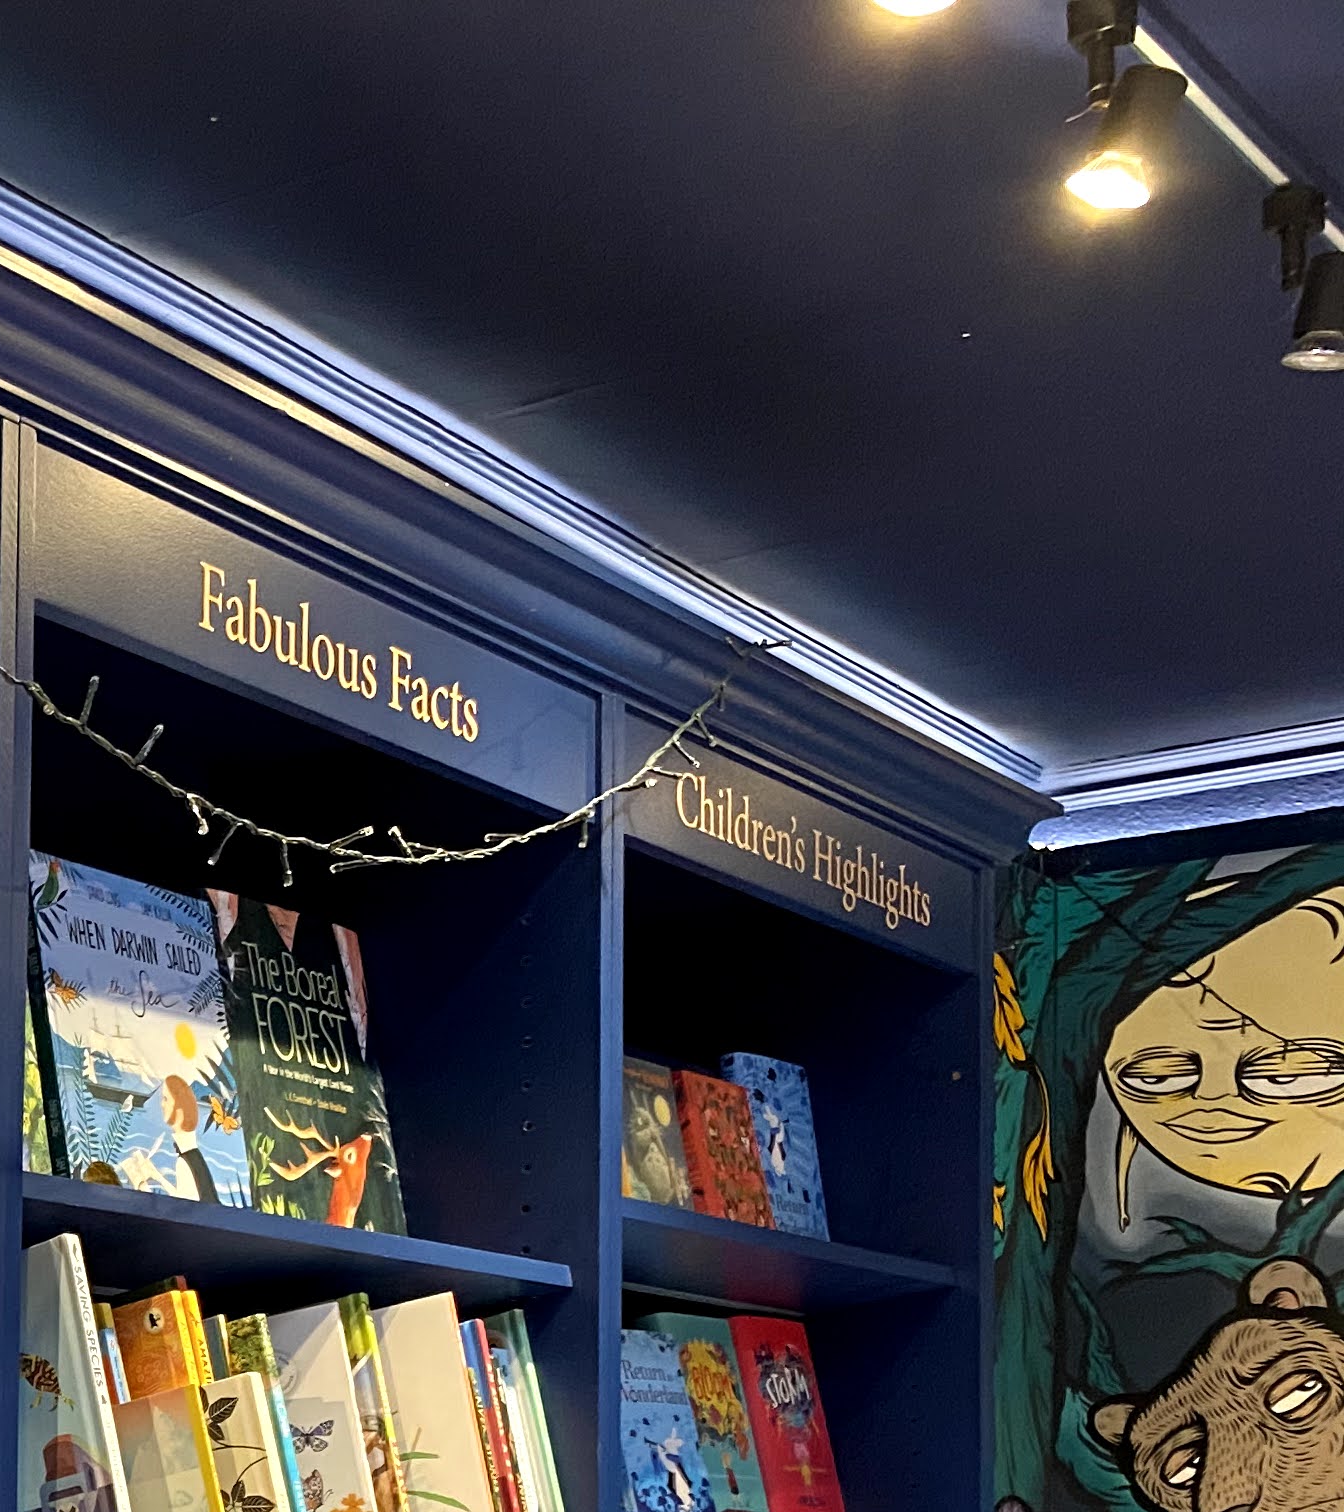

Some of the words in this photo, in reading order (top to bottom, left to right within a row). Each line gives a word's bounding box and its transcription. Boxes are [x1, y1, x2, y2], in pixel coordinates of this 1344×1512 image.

[197, 561, 378, 700] Fabulous
[389, 644, 480, 744] Facts
[675, 772, 806, 877] Children's
[812, 828, 932, 933] Highlights
[68, 918, 107, 951] WHEN
[111, 929, 158, 966] DARWIN
[165, 943, 202, 977] SAILED
[242, 941, 280, 989] The
[284, 951, 347, 1011] Boreal
[131, 969, 177, 1019] Sea
[252, 993, 350, 1076] FOREST
[71, 1264, 96, 1328] SAVING
[84, 1328, 105, 1390] SPECIES
[765, 1370, 810, 1410] STORM
